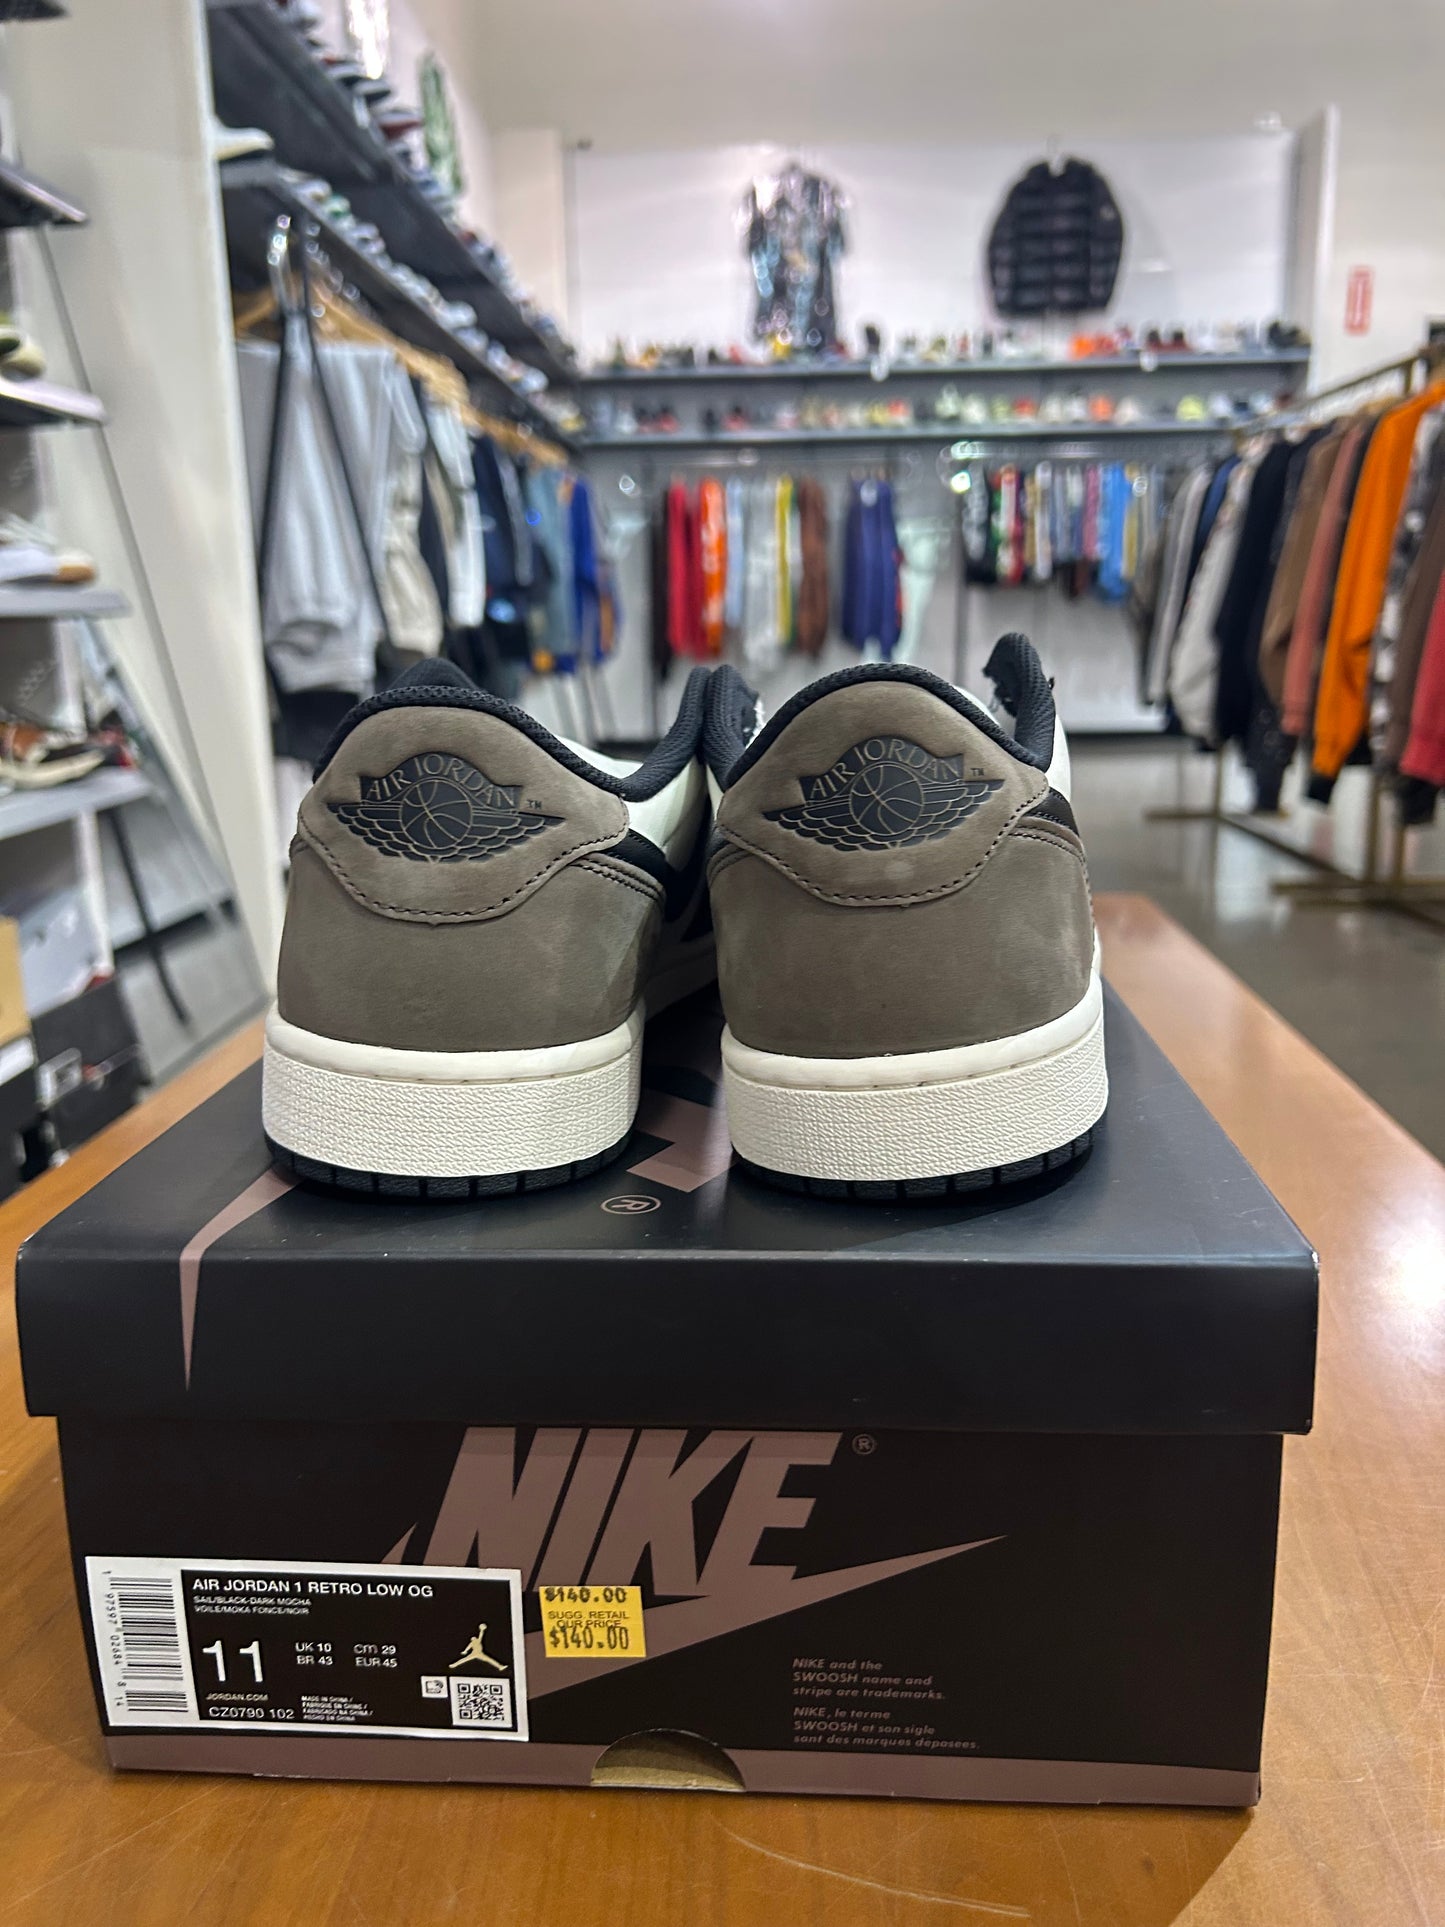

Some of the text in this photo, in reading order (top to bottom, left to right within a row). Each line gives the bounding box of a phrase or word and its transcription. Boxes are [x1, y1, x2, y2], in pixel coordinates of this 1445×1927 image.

[366, 768, 412, 800] AIR
[810, 762, 855, 799] AIR
[422, 1426, 843, 1597] NIKE
[193, 1578, 433, 1597] AIR JORDAN 1 RETRO LOW OG
[589, 1611, 630, 1619] RETAIL
[556, 1619, 622, 1629] OUR PRICE
[549, 1625, 630, 1649] $140.00
[295, 1642, 332, 1653] UK 10
[381, 1645, 396, 1655] 29
[202, 1640, 263, 1682] 11
[296, 1655, 333, 1666] BR 43
[355, 1657, 398, 1668] EUR 45
[792, 1658, 883, 1670] NIKE and the
[793, 1671, 934, 1685] SWOOSH name and
[206, 1693, 268, 1701] JORDAN.COM
[793, 1686, 832, 1698] stripe
[836, 1689, 859, 1697] are
[208, 1706, 295, 1719] CZ0790 102
[834, 1708, 847, 1718] le
[850, 1709, 891, 1719] terme
[794, 1720, 936, 1736] SWOOSH et son sigle
[793, 1735, 823, 1745] sont
[826, 1734, 849, 1744] des
[853, 1737, 911, 1748] marques
